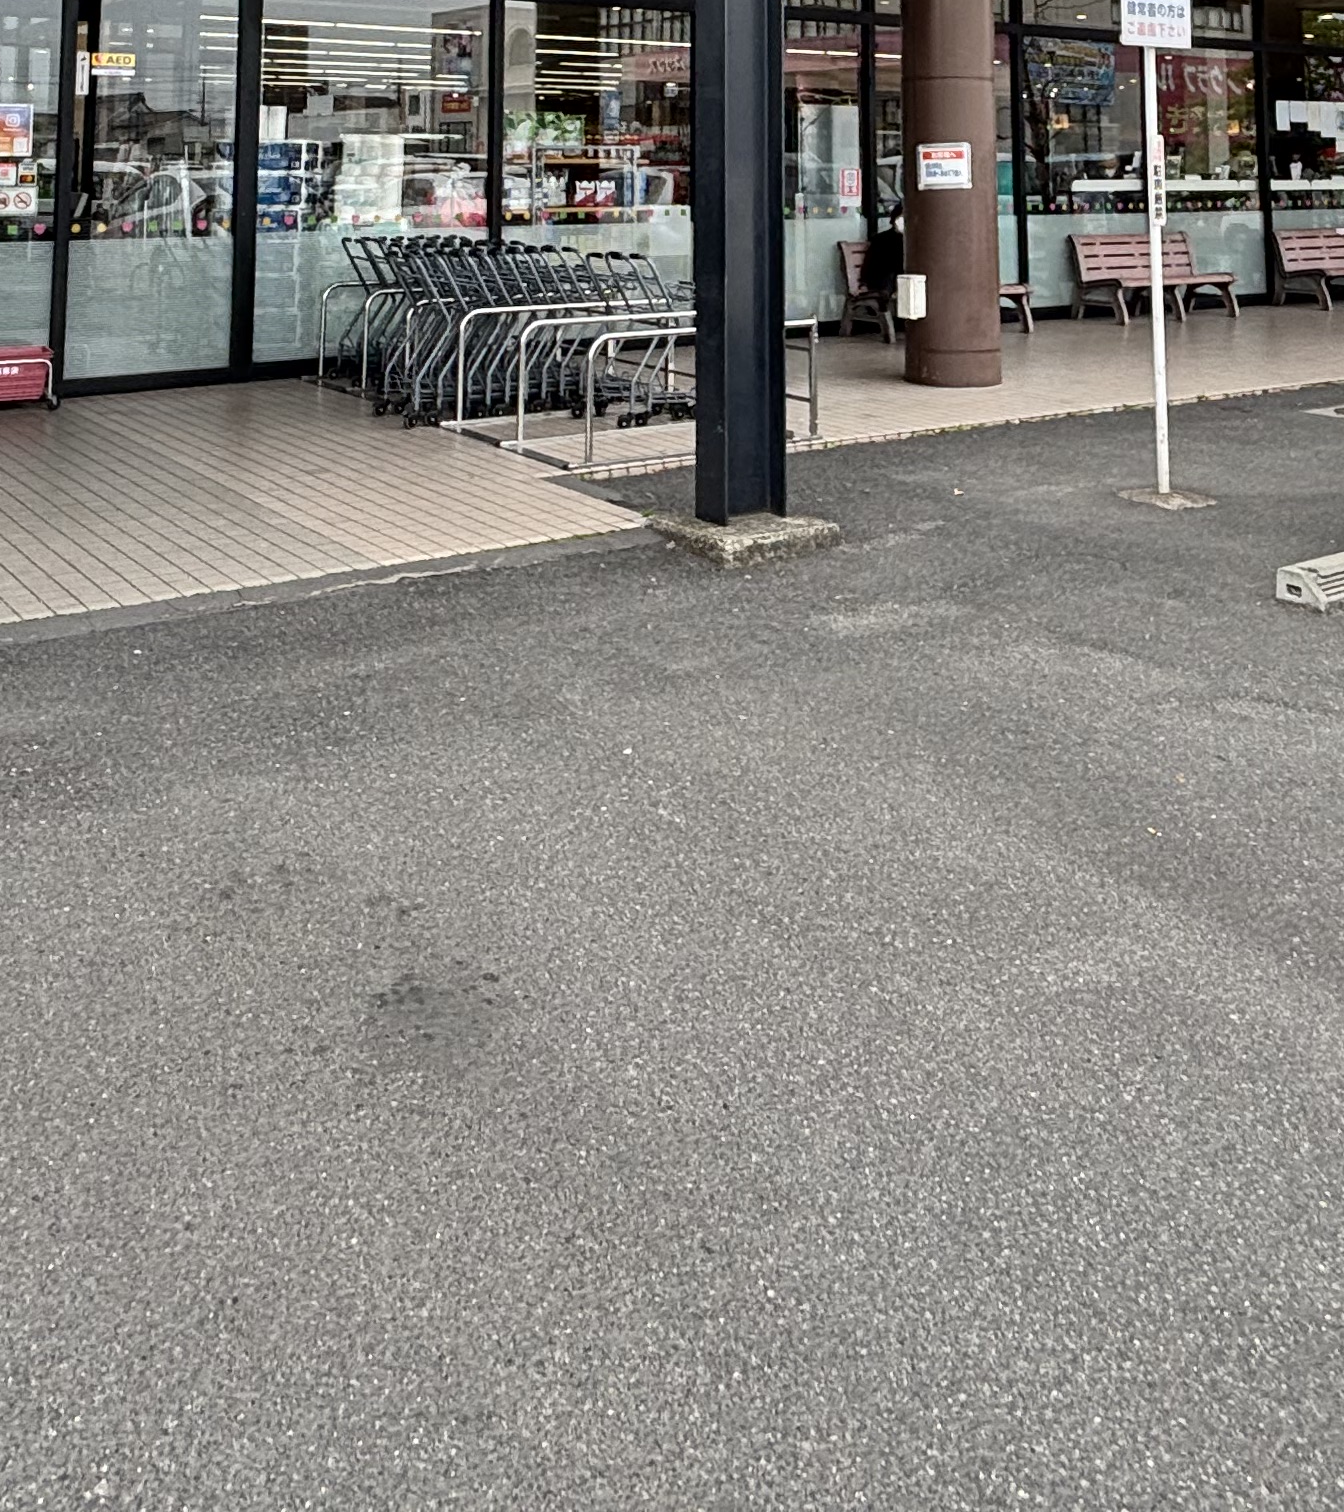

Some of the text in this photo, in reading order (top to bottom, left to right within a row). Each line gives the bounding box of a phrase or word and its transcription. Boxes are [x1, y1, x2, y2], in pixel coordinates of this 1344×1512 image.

[1127, 1, 1185, 19] 健常者の方は
[1127, 21, 1186, 38] ご遠慮下さい
[106, 55, 132, 65] AED
